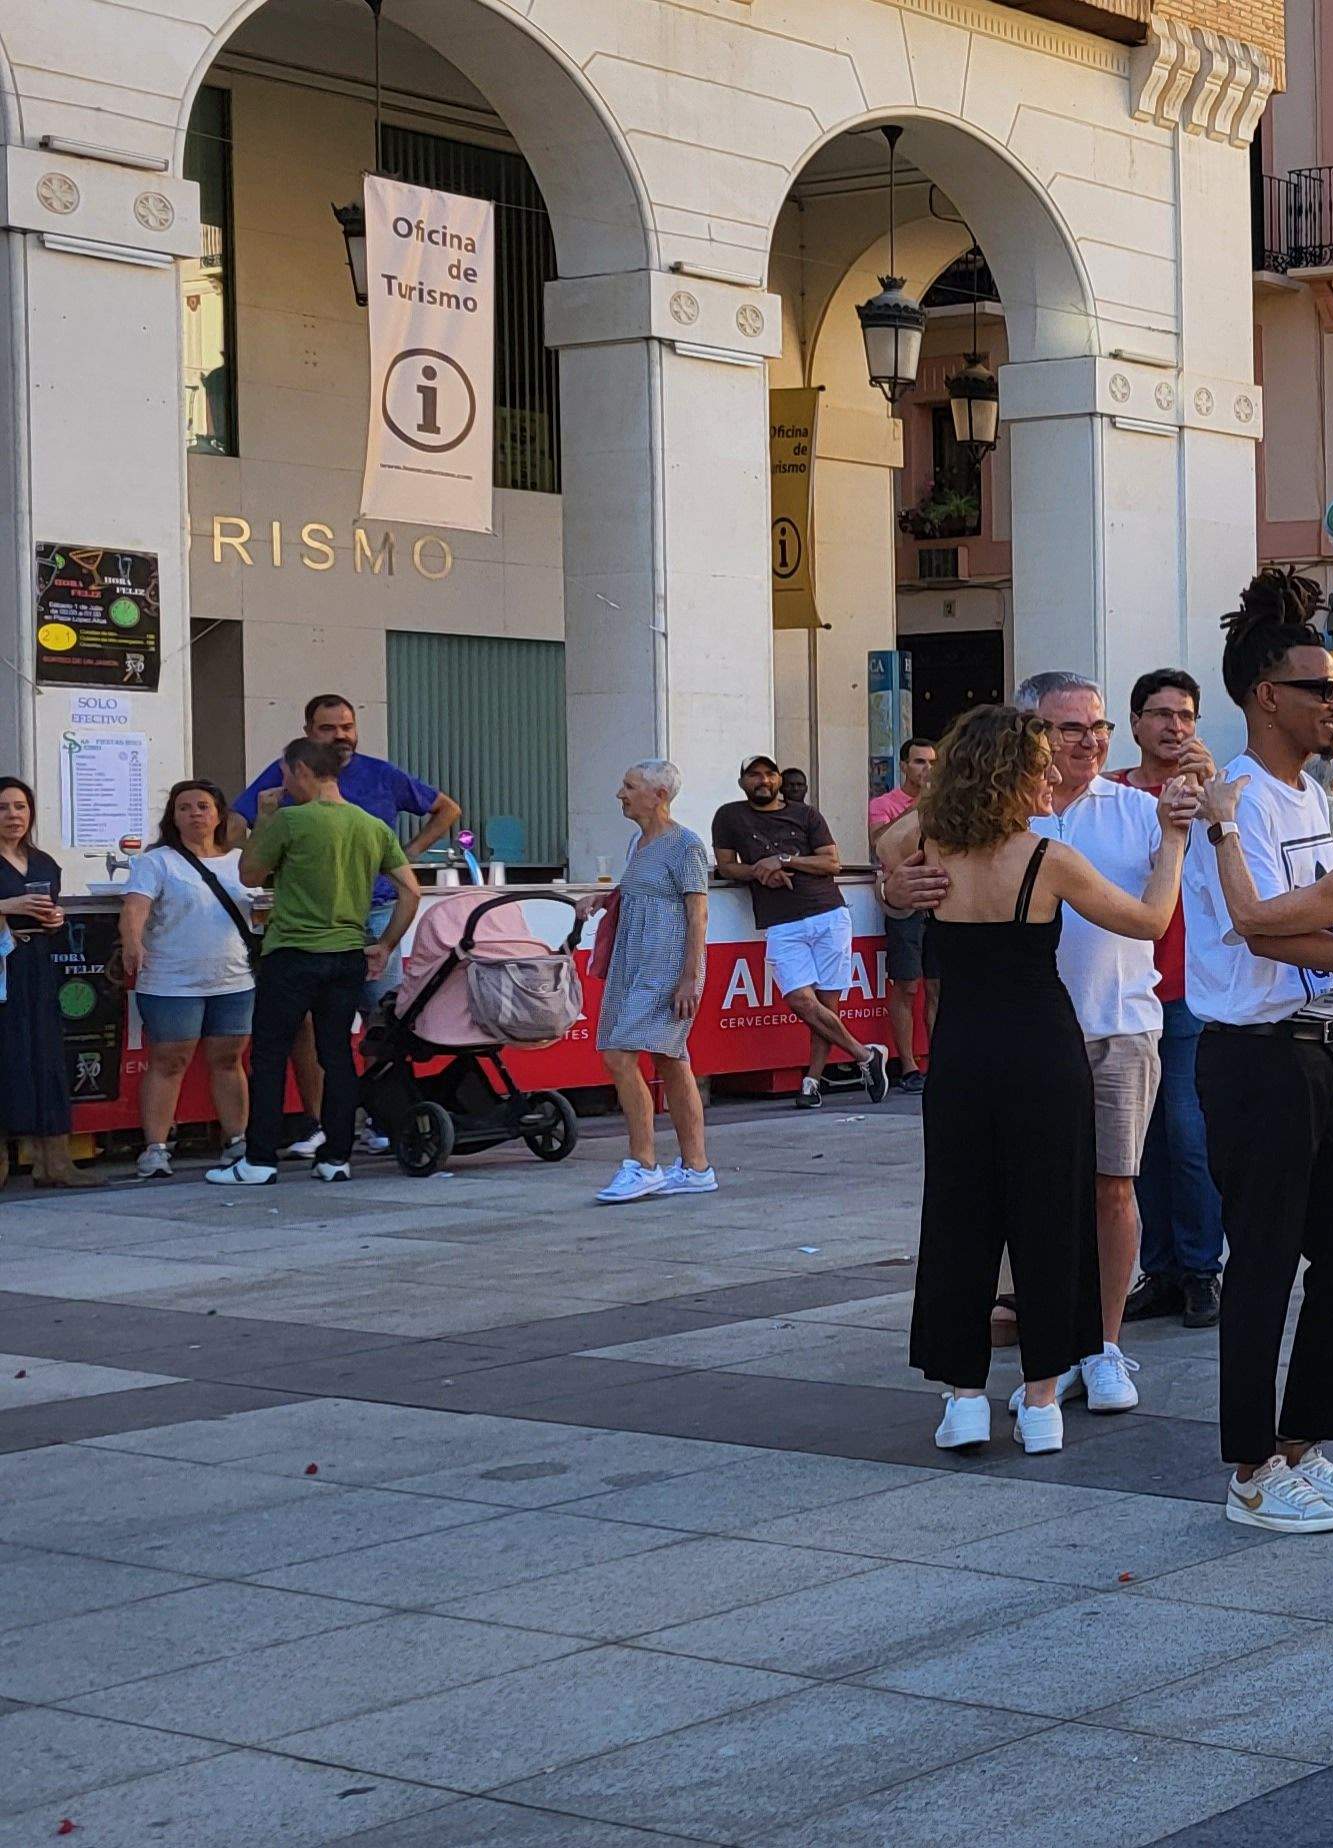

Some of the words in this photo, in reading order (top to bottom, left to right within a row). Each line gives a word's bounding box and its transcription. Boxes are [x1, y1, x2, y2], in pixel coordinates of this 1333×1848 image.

[392, 217, 476, 253] Oficina
[448, 258, 478, 283] de
[381, 273, 478, 313] Turismo
[793, 442, 808, 456] de
[187, 514, 452, 581] RISMO
[78, 697, 118, 710] SOLO
[71, 713, 128, 725] EFECTIVO
[65, 964, 105, 975] FELIZ
